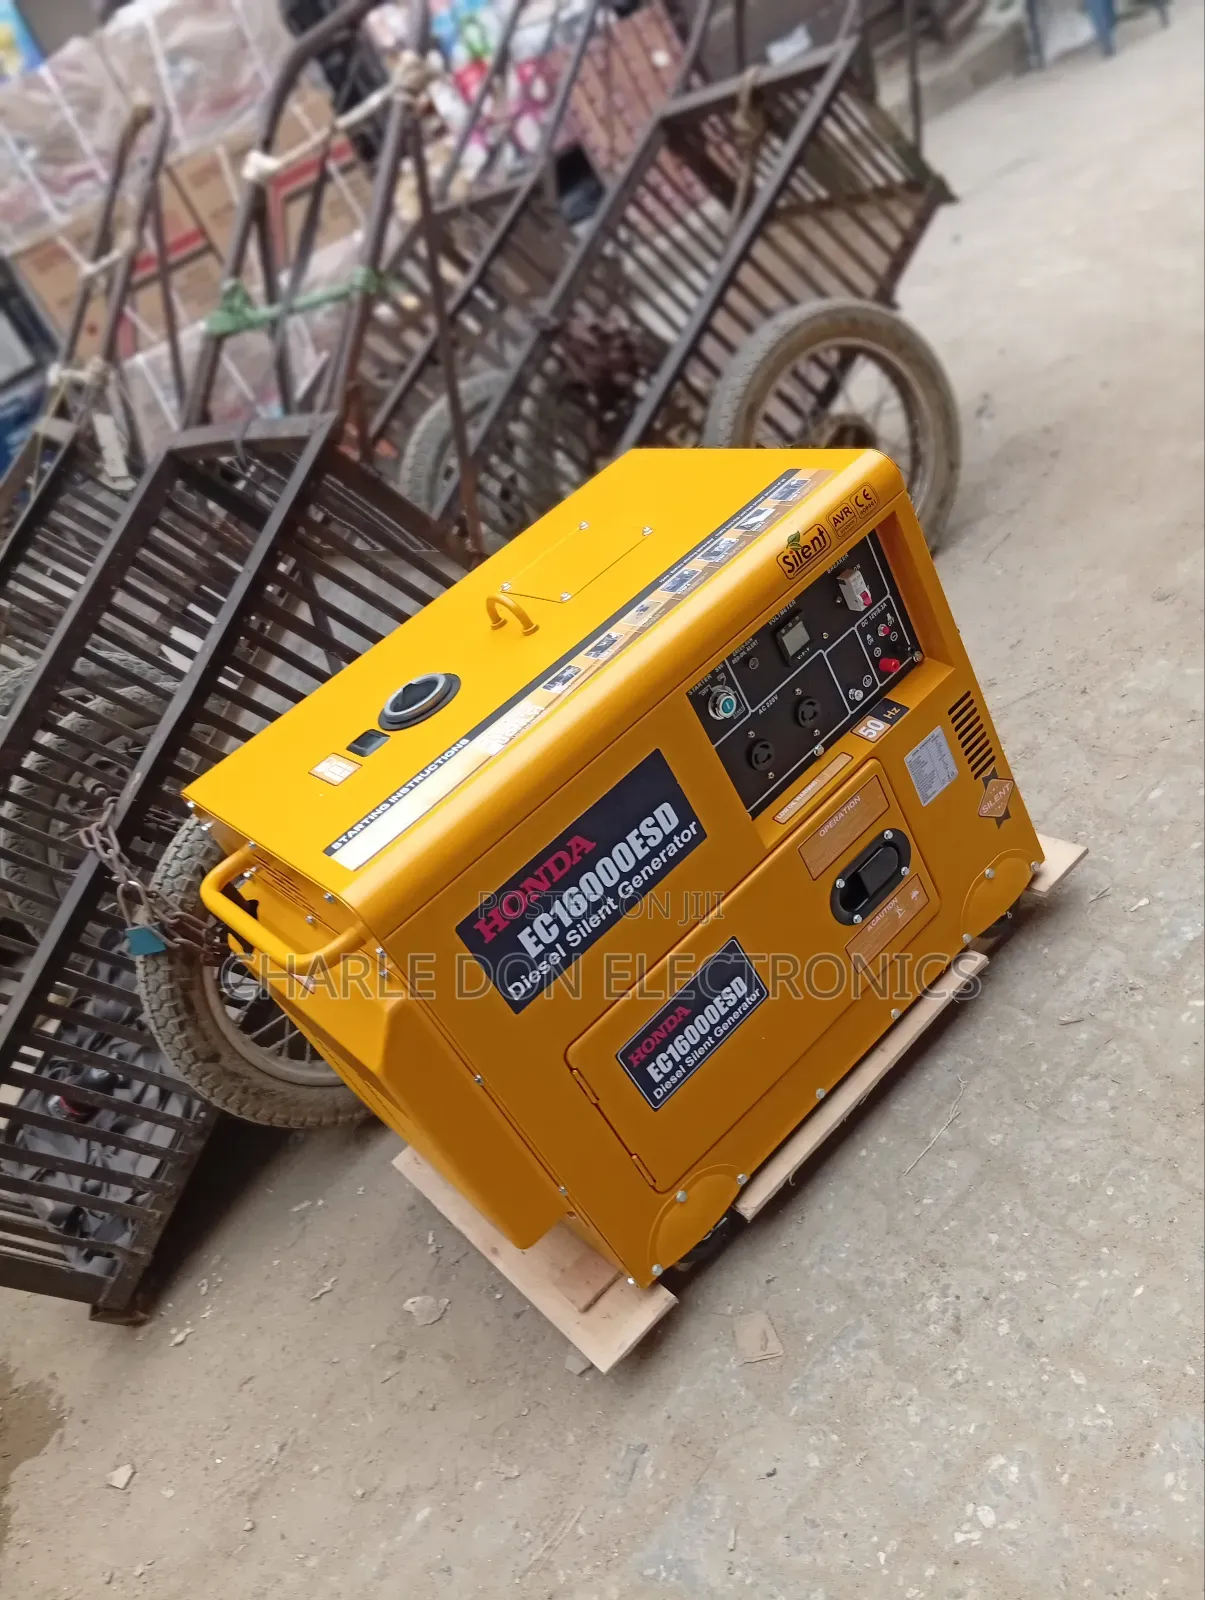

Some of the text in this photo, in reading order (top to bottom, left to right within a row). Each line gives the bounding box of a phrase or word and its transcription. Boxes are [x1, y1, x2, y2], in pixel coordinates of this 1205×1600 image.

[832, 506, 852, 527] AVR
[782, 527, 827, 573] Silent
[861, 620, 869, 628] DC
[688, 674, 712, 696] STARTER
[758, 694, 779, 715] AC 220V
[858, 707, 901, 738] 50 Hz
[331, 802, 391, 850] STARTING
[388, 738, 470, 804] INSTRUCTIONS
[819, 795, 861, 837] OPERATION
[982, 782, 1010, 813] SILENT
[473, 834, 597, 944] HONDA
[517, 802, 679, 959] EC16000ESD
[507, 820, 698, 1001] Diesel Silent Generator
[870, 897, 898, 927] CAUTION
[628, 1005, 692, 1068] HONDA
[646, 976, 748, 1083] EC16000ESD
[653, 988, 761, 1100] Diesel Silent Generator
